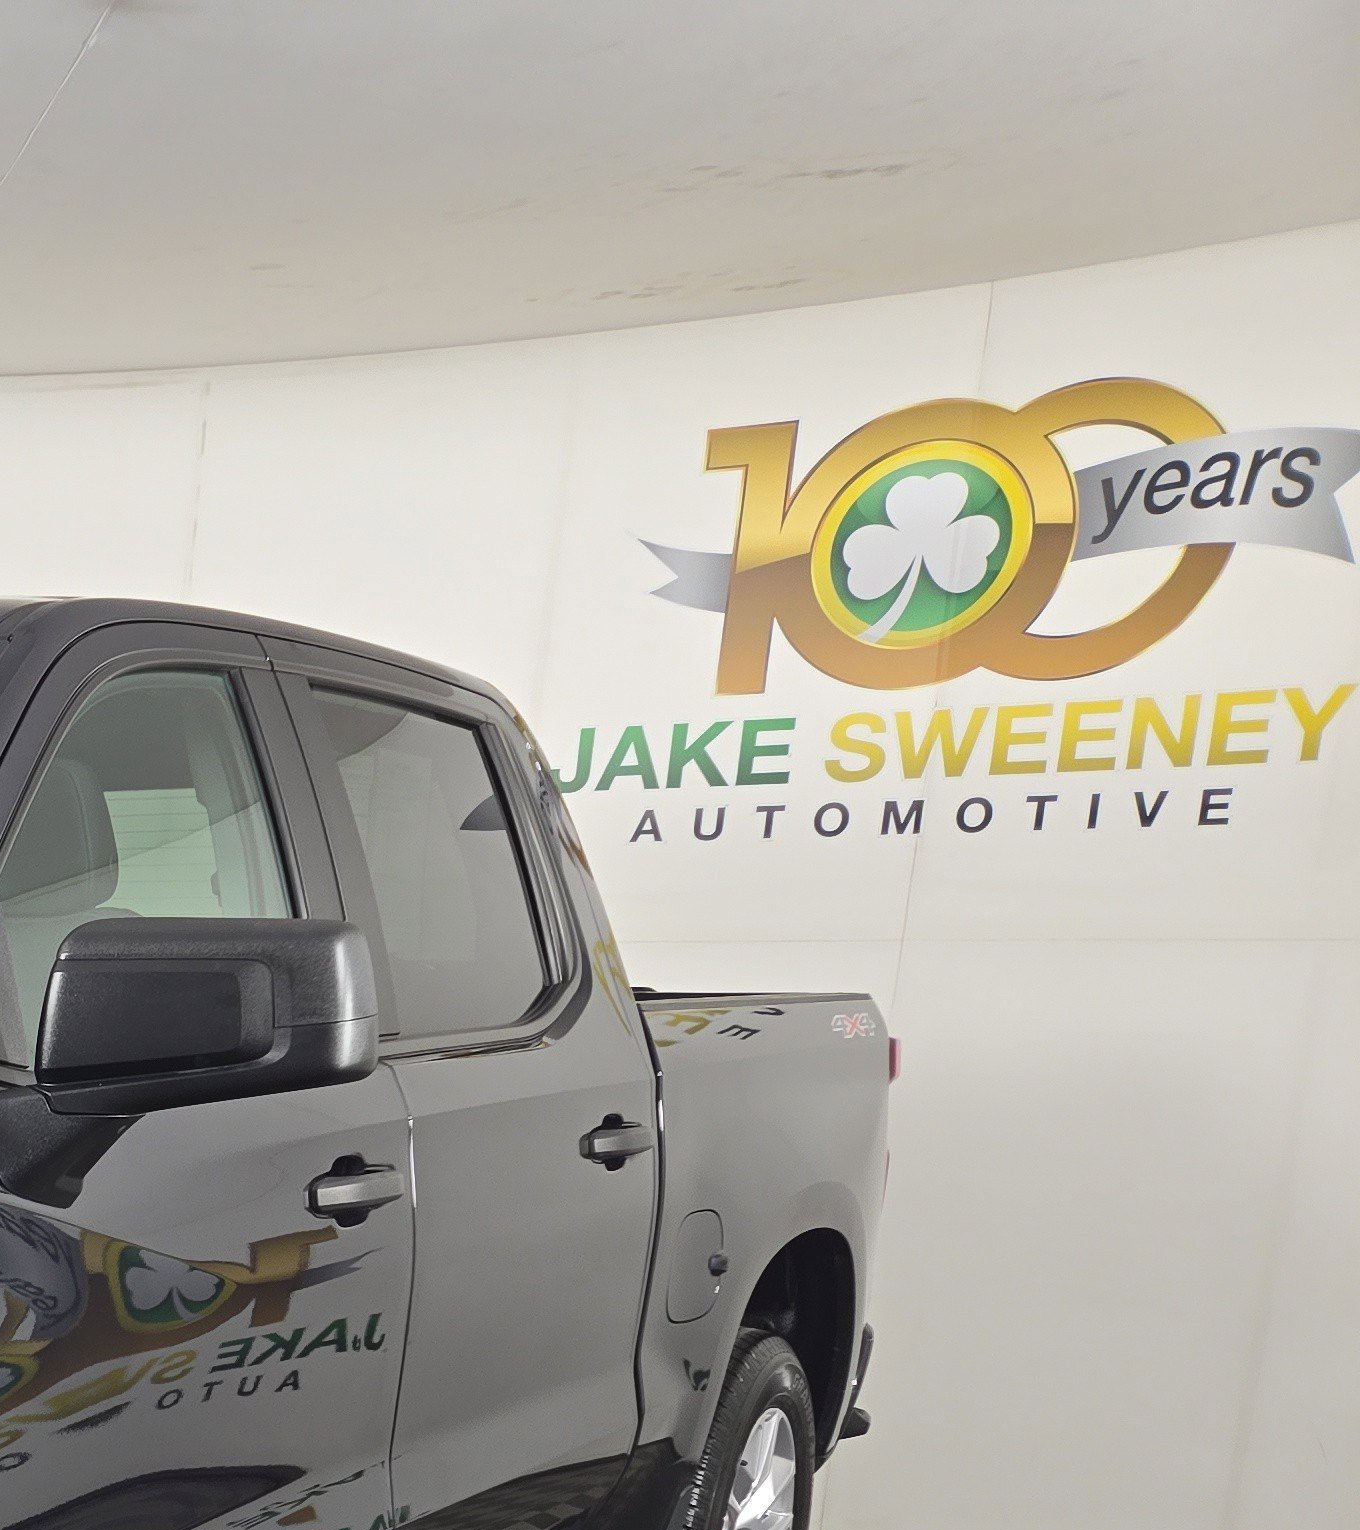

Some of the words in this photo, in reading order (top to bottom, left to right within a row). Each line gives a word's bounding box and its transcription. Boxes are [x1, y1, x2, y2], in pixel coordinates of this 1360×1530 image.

[1091, 444, 1321, 545] years
[552, 717, 797, 795] JAKE
[824, 683, 1357, 784] SWEENEY
[630, 786, 1235, 843] AUTOMOTIVE
